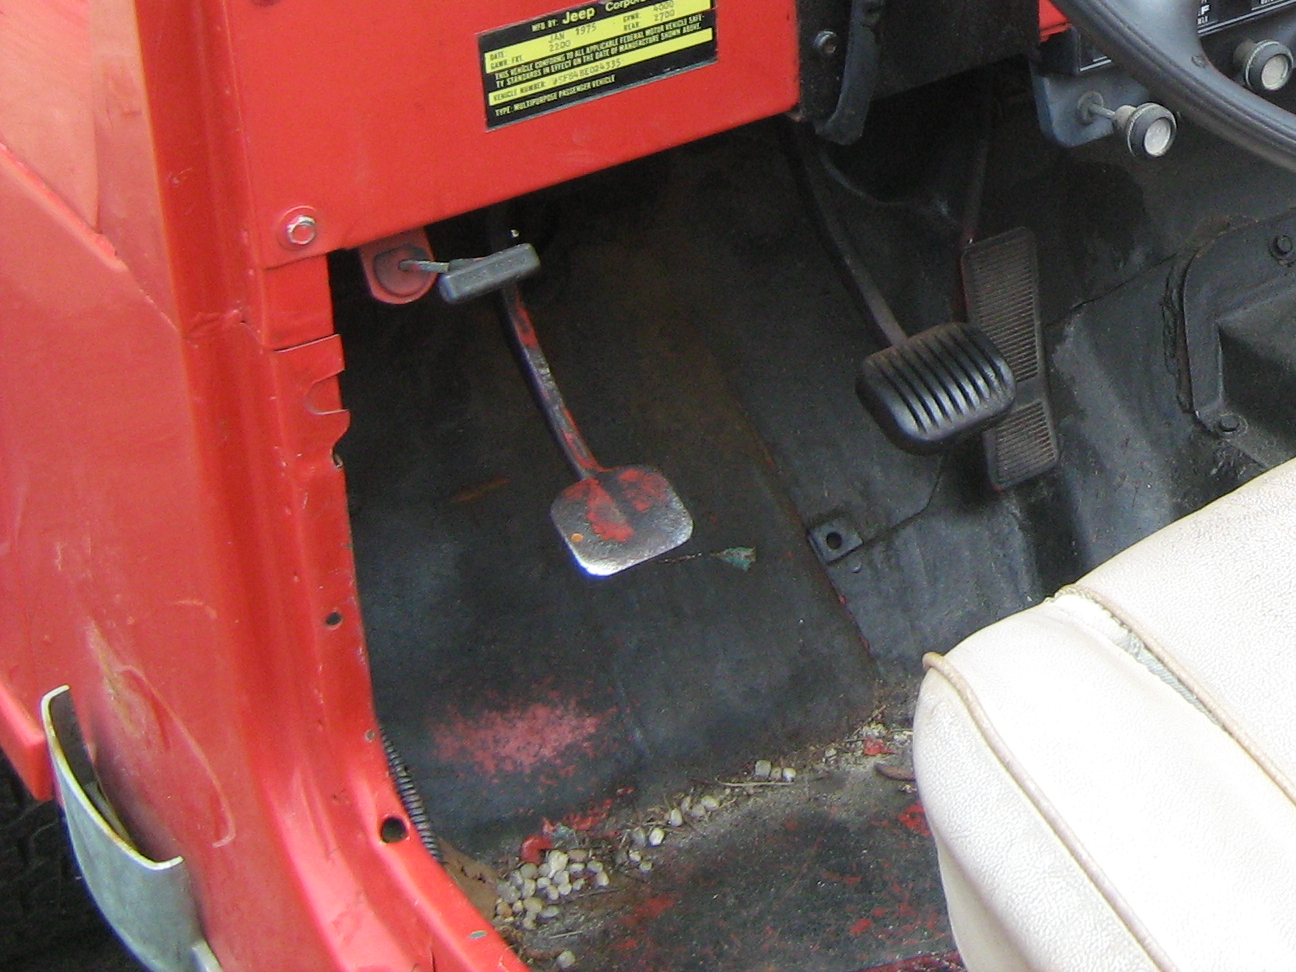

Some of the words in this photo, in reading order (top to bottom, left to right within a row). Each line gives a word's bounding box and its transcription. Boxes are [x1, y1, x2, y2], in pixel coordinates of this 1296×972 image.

[548, 39, 572, 53] 2200
[652, 8, 676, 22] 2700
[548, 31, 566, 45] JAN
[575, 22, 598, 36] 1975
[561, 7, 596, 25] Jeep
[495, 69, 510, 81] THIS
[510, 62, 534, 77] VEHICLE
[566, 50, 575, 60] TO
[574, 47, 586, 58] ALL
[585, 38, 619, 55] APPLICABLE
[619, 31, 645, 45] FEDERAL
[645, 25, 666, 38] MOTOR
[665, 18, 689, 32] VEHICLE
[688, 13, 706, 25] SAFE-
[496, 79, 506, 89] TY
[505, 68, 542, 86] STANDARDS
[542, 66, 551, 75] IN
[550, 59, 572, 73] EFFECT
[572, 56, 582, 66] ON
[582, 52, 595, 64] THE
[594, 47, 611, 60] DATE
[610, 46, 619, 56] OF
[618, 35, 660, 53] MANUFACTURE
[660, 27, 682, 41] SHOWN
[492, 88, 518, 102] VEHICLE
[513, 91, 559, 111] MULTIPURPOSE
[558, 81, 592, 98] PASSENGER
[591, 73, 617, 88] VEHICLE
